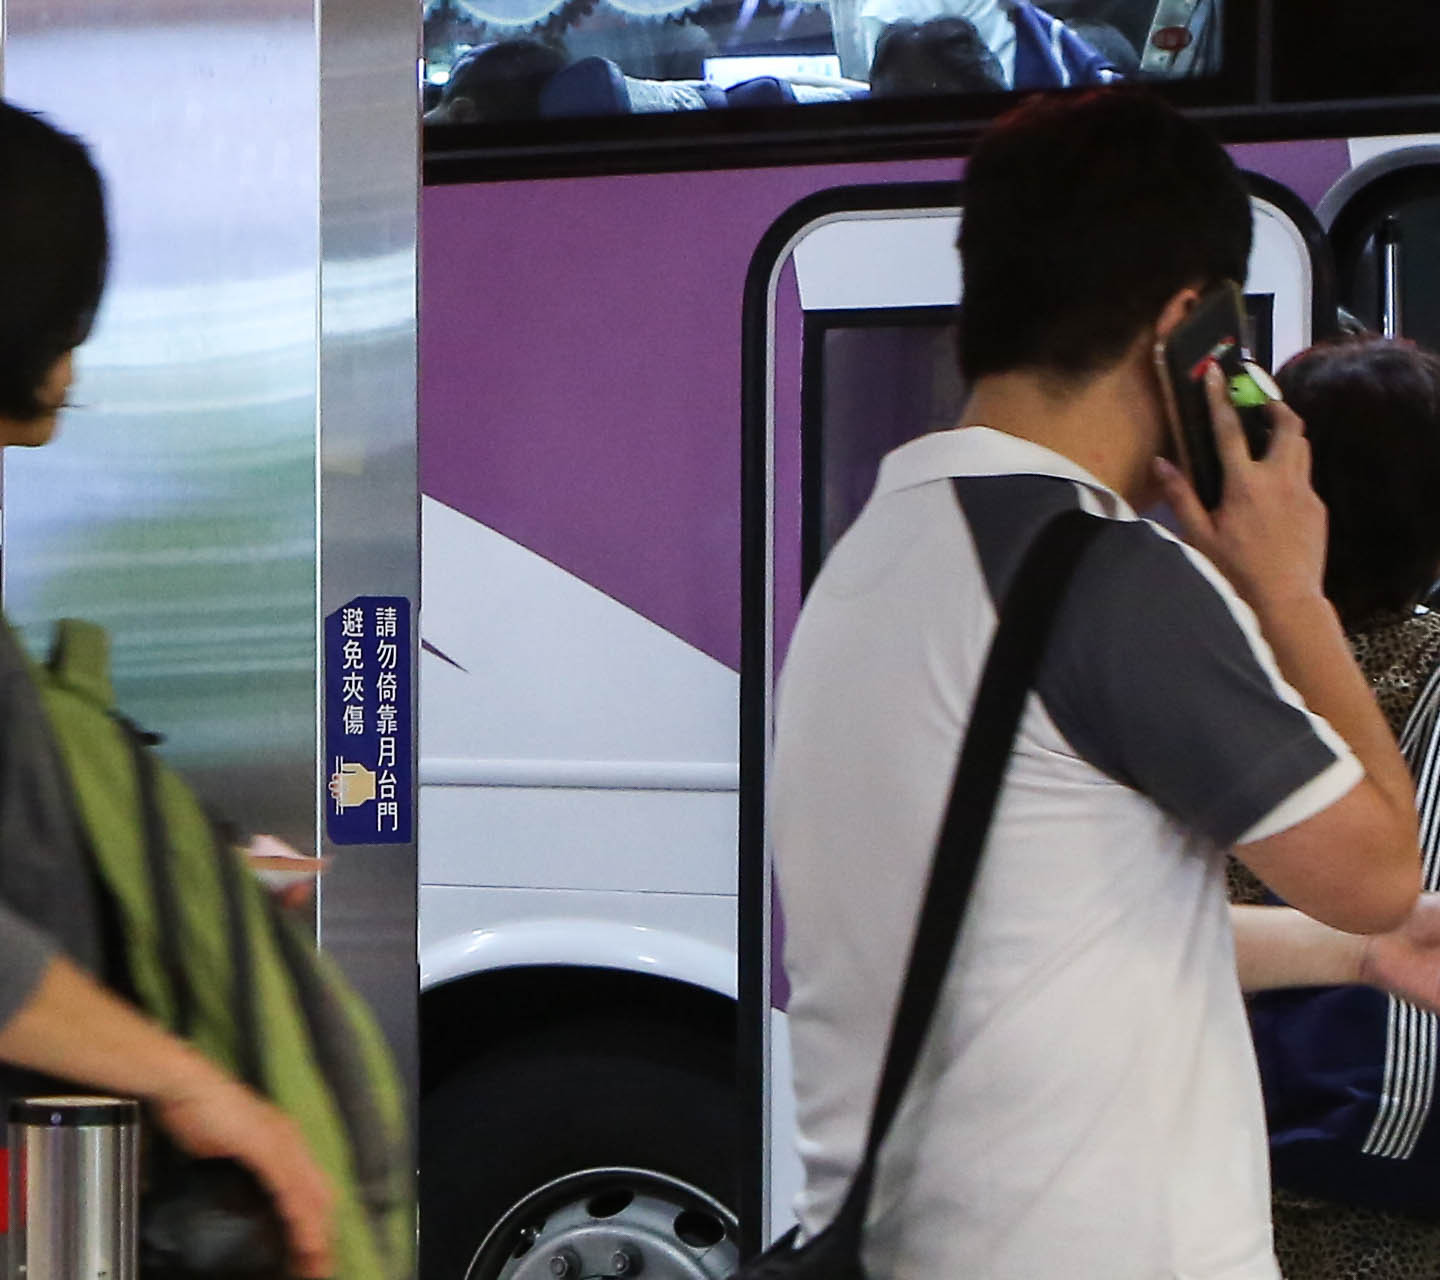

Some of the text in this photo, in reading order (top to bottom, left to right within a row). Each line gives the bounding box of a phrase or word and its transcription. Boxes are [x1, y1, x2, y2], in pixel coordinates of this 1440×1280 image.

[342, 607, 364, 735] 避免夾傷
[375, 607, 398, 832] 請勿倚靠月台門
